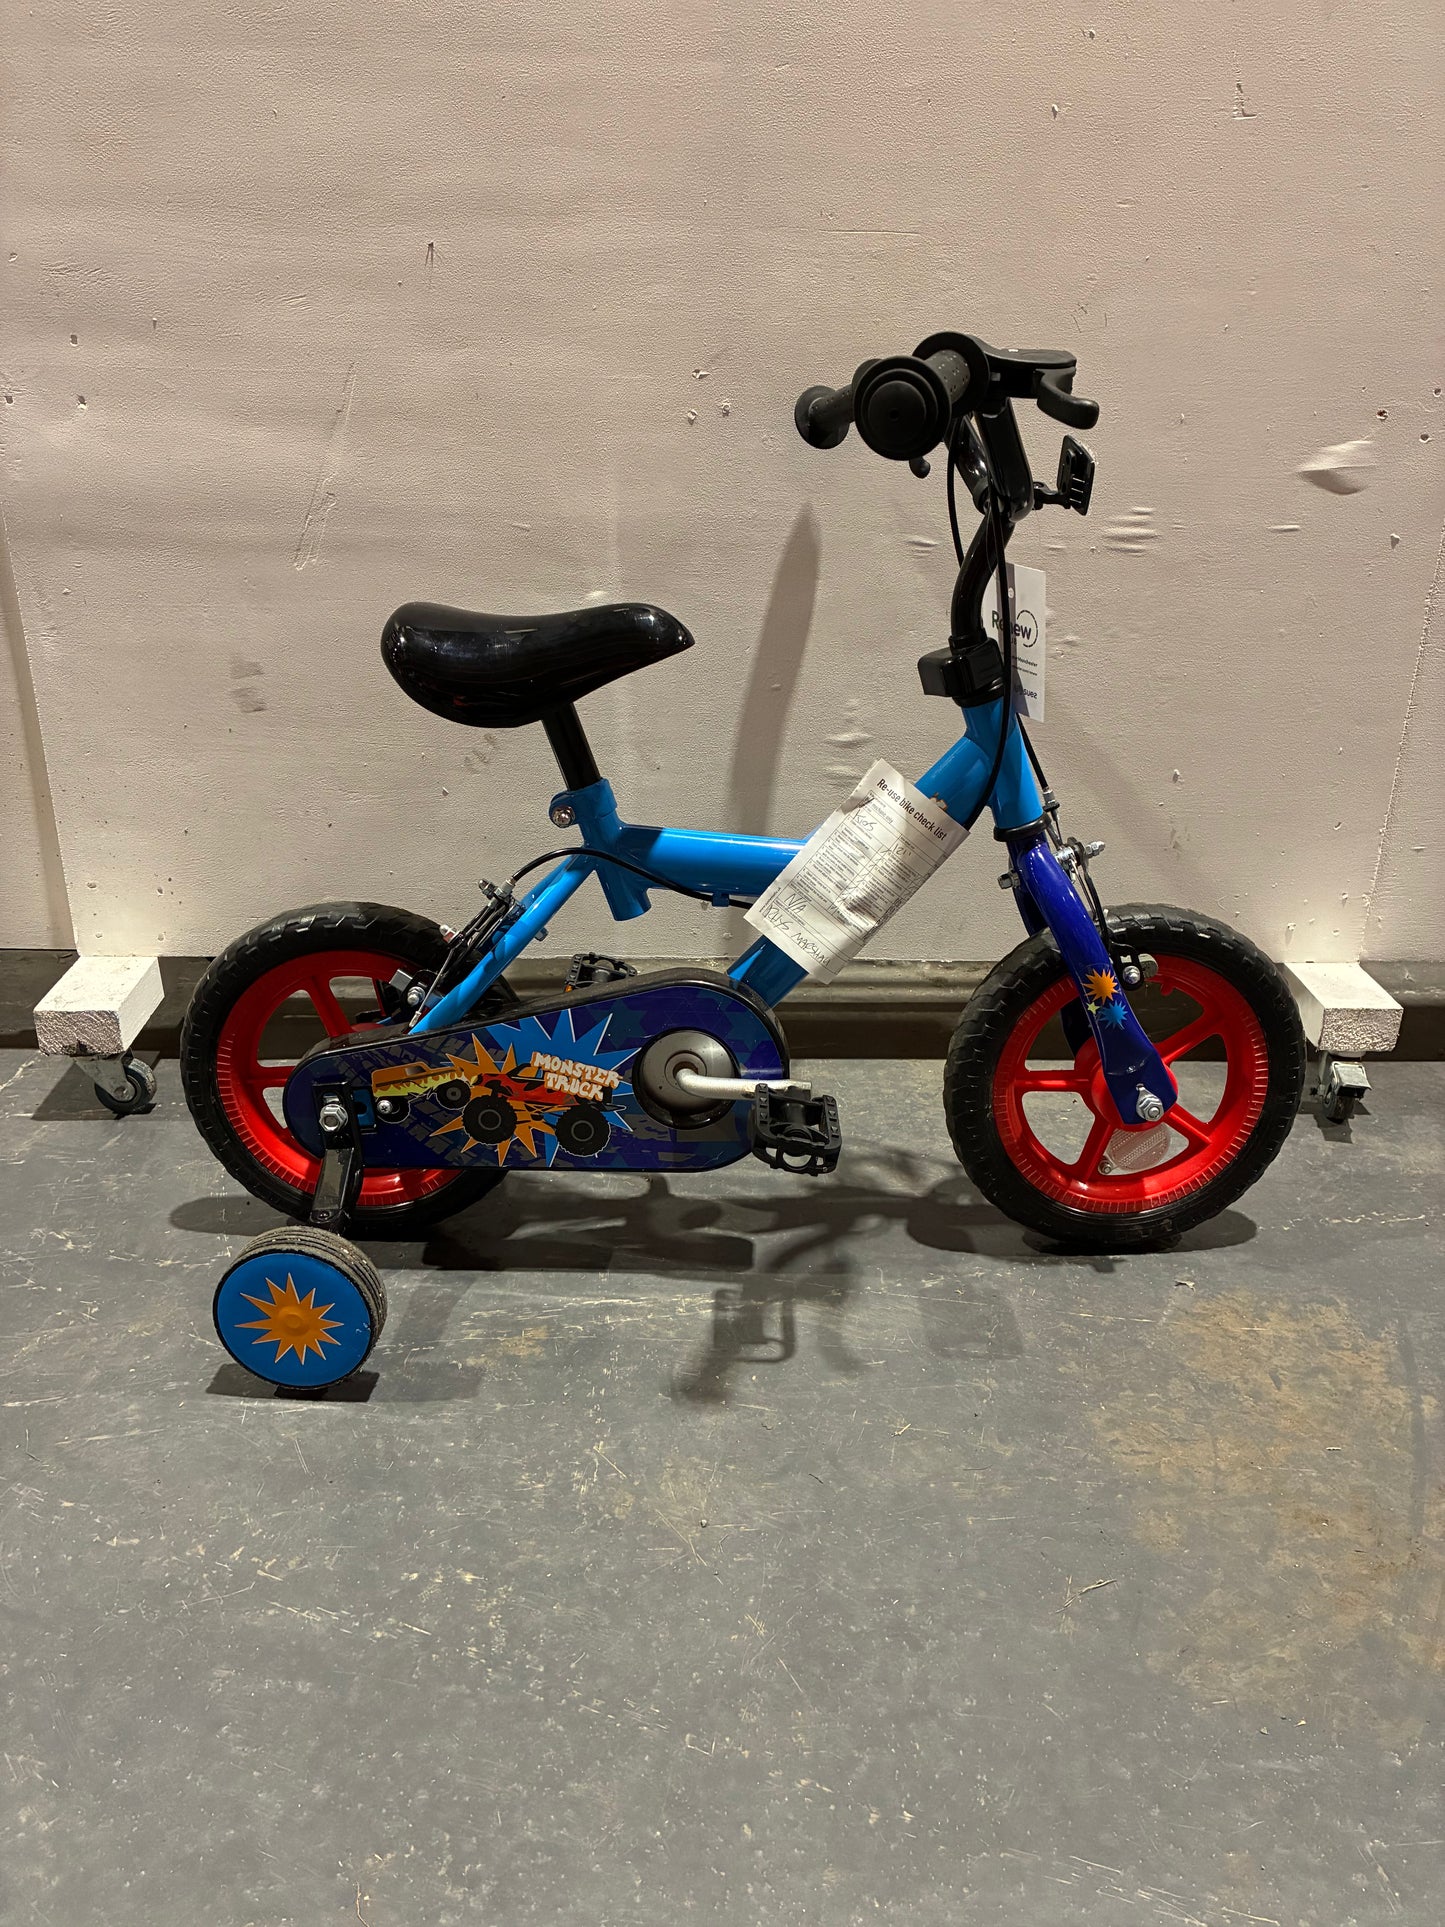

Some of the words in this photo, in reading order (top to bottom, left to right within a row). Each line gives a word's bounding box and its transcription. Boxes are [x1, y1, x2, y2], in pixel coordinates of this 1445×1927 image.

[992, 610, 1032, 640] Reew
[877, 778, 901, 802] Re-use
[899, 798, 915, 815] bike
[913, 811, 936, 832] check
[933, 826, 947, 841] list
[530, 1051, 622, 1090] MONSTER
[543, 1072, 604, 1102] TRUCK
